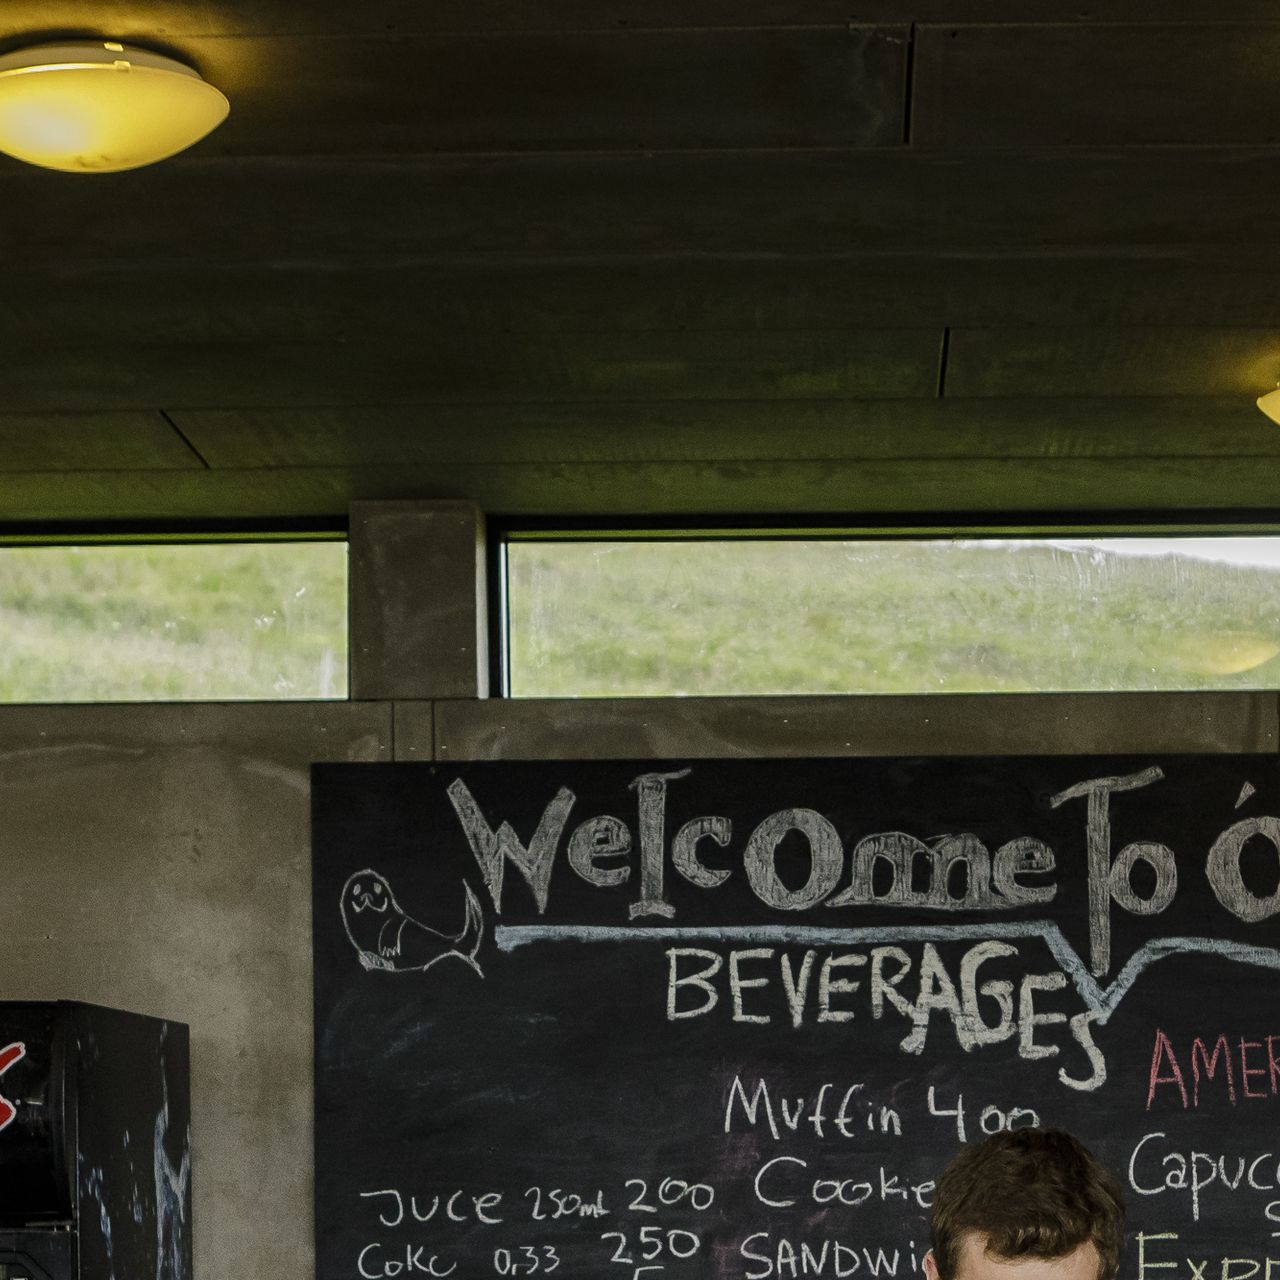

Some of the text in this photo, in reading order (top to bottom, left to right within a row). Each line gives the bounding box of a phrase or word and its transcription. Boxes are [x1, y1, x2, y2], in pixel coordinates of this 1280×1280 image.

[1051, 766, 1177, 976] To
[665, 940, 1107, 1091] BEVERAGES
[724, 1075, 902, 1140] Muffin
[624, 1177, 715, 1212] 200
[601, 1226, 701, 1266] 250
